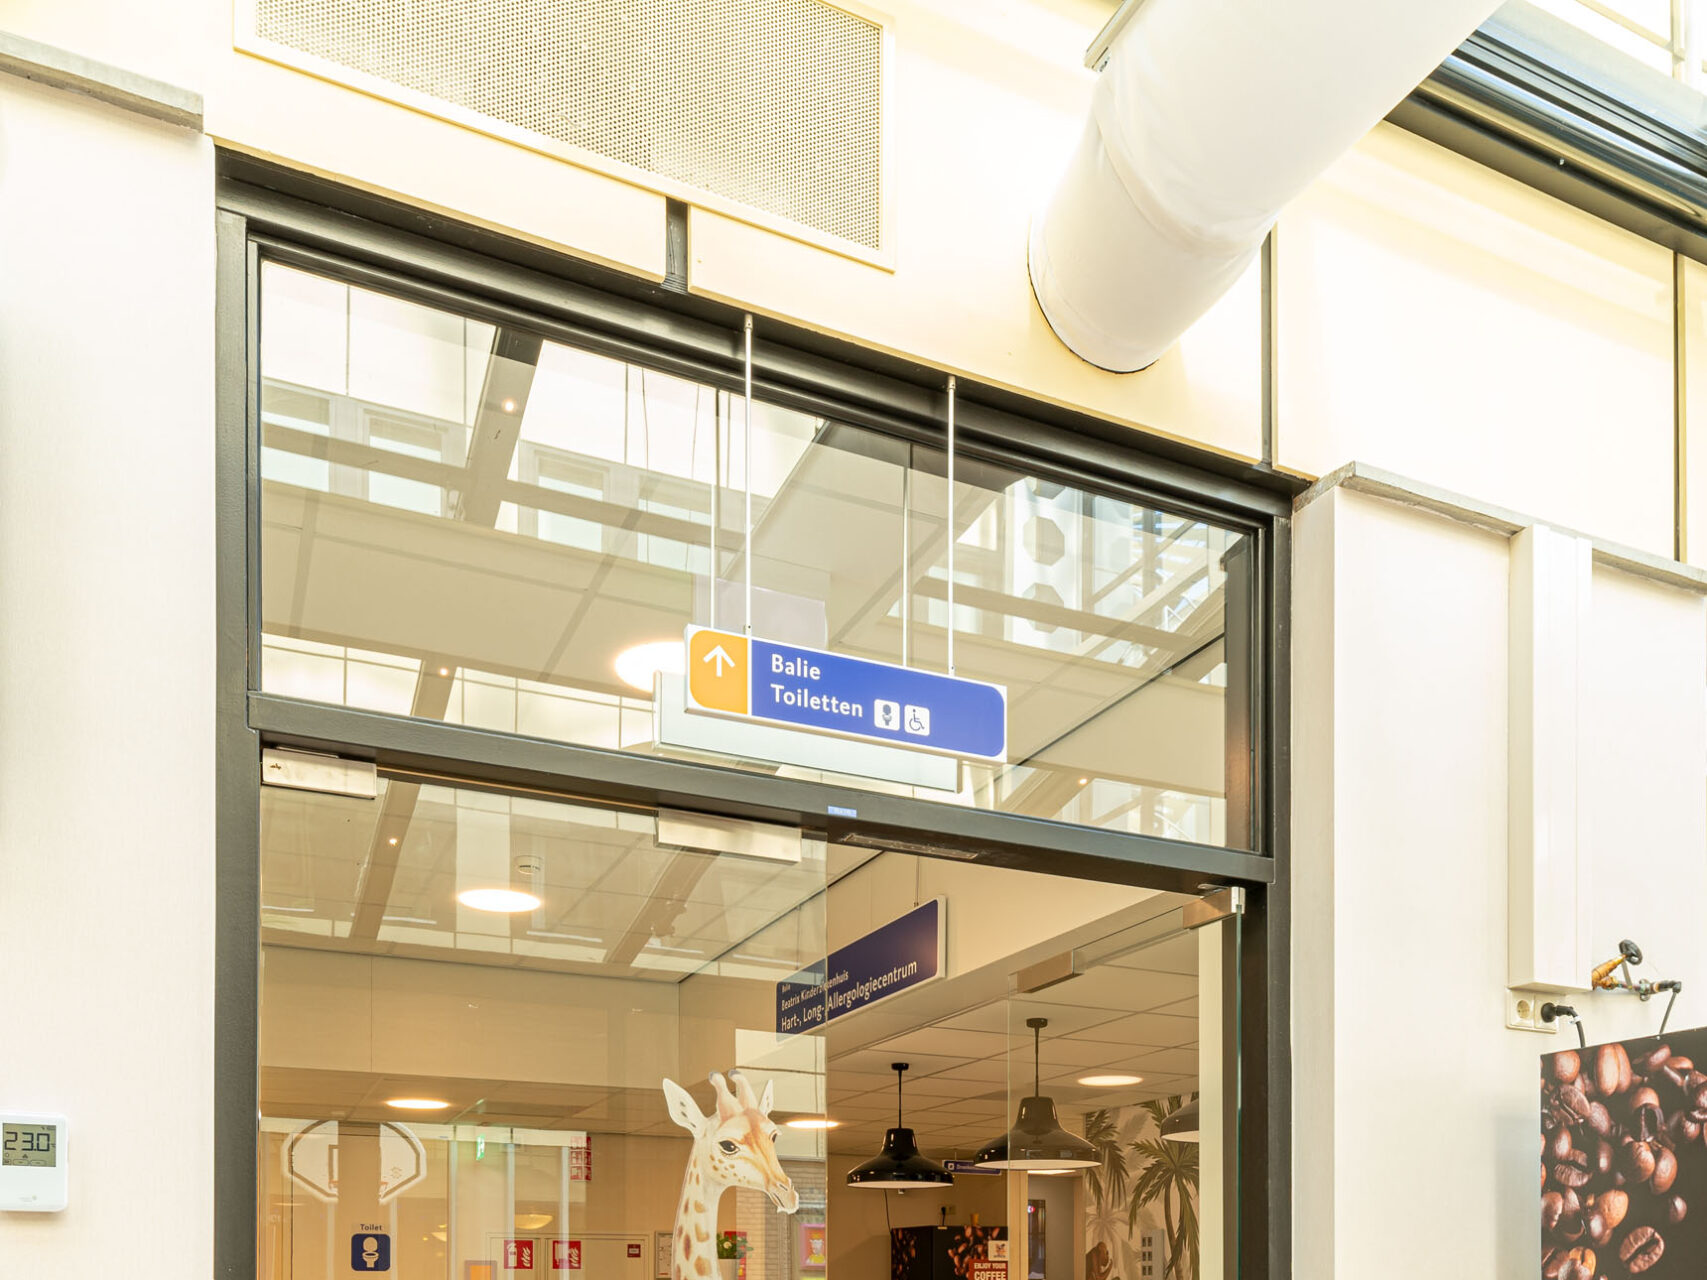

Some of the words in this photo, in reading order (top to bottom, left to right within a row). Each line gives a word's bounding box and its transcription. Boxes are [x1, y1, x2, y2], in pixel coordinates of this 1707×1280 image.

[770, 653, 821, 681] Balie
[770, 683, 864, 718] Toiletten
[827, 961, 917, 1011] Allergologiecentrum
[781, 994, 800, 1011] Beatrix
[4, 1131, 50, 1152] 23.0
[360, 1223, 382, 1231] Toilet
[974, 1271, 1006, 1280] COFFEE
